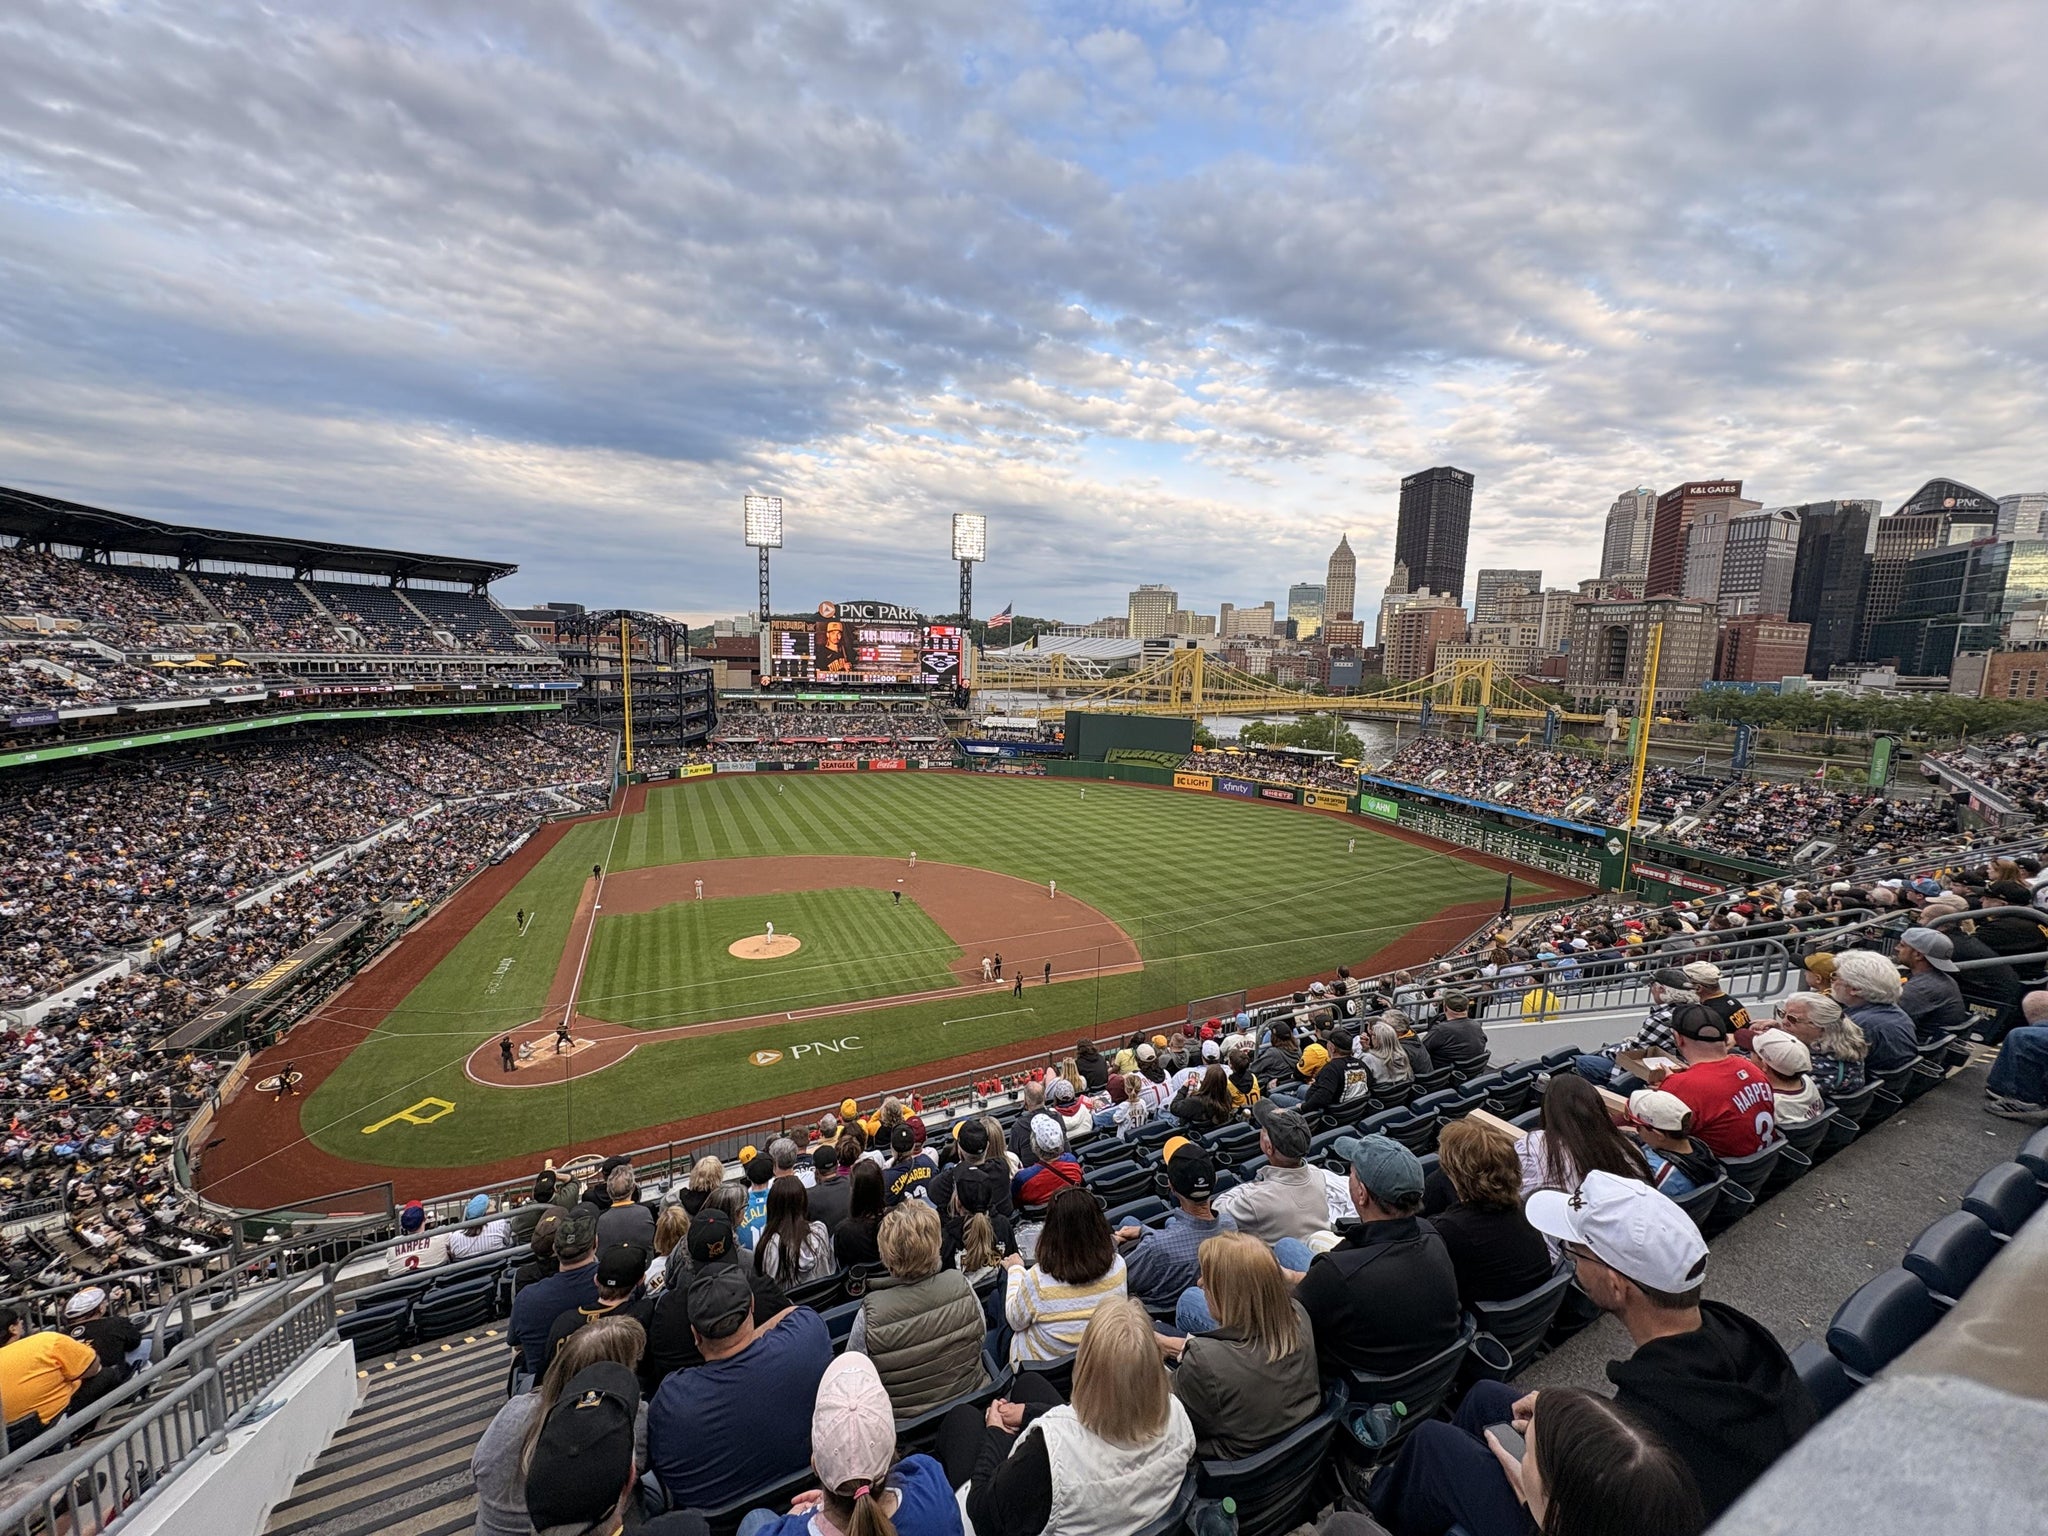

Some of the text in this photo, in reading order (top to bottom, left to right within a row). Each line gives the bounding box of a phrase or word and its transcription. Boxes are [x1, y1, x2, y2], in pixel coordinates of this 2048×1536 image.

[1707, 485, 1736, 494] GATES
[1909, 502, 1923, 513] PNC
[1956, 498, 1981, 507] PNC
[840, 604, 920, 620] PNC PARK
[1177, 777, 1209, 788] IC LIGHT
[1222, 782, 1248, 794] xfinity
[1263, 789, 1292, 799] SHEETZ
[1375, 802, 1390, 813] AHN
[788, 1036, 864, 1059] PNC
[1755, 1111, 1774, 1152] 3
[890, 1167, 932, 1195] SCHWARBER
[394, 1237, 430, 1257] HARPER
